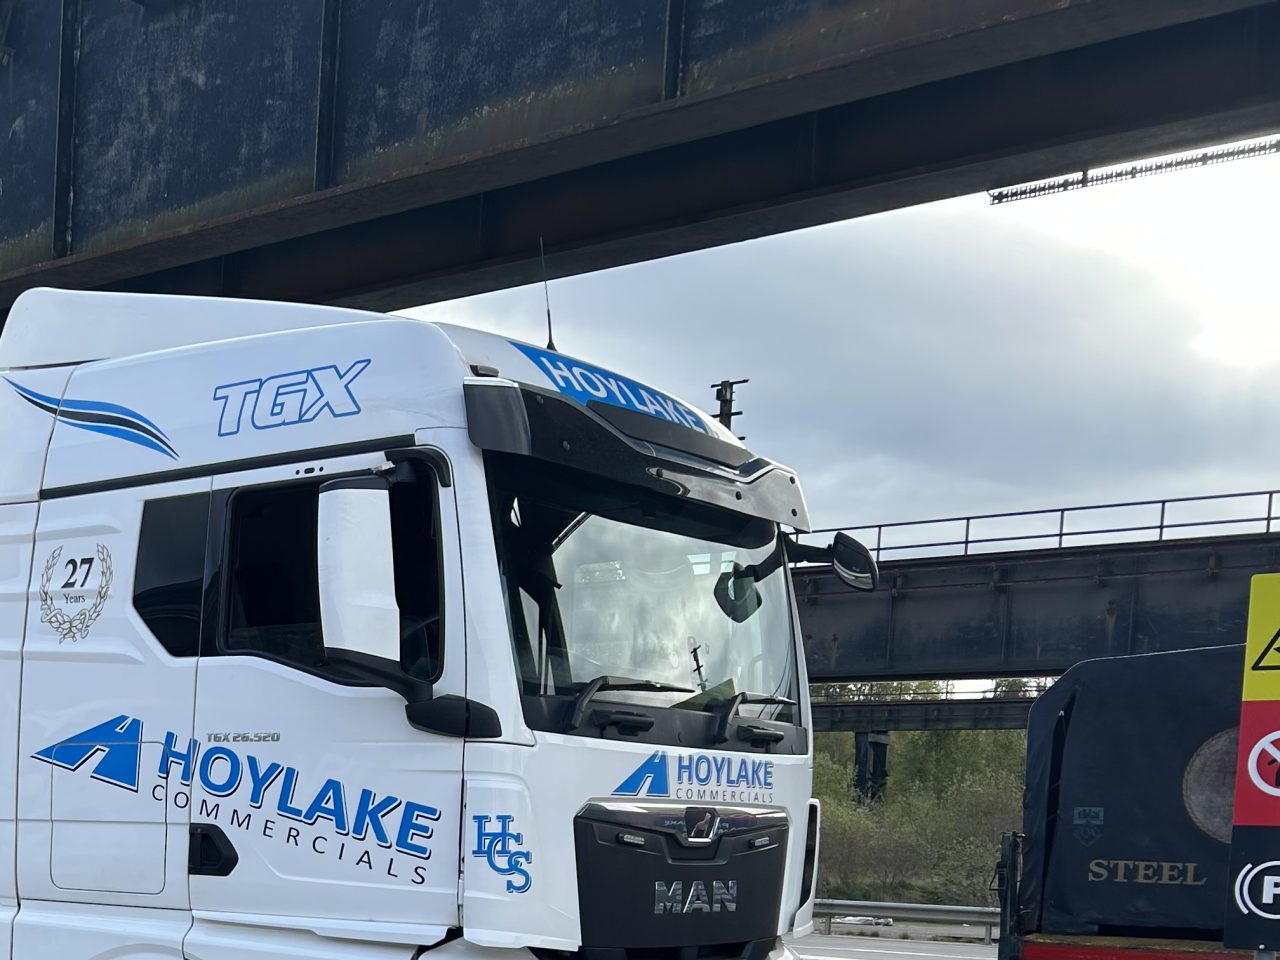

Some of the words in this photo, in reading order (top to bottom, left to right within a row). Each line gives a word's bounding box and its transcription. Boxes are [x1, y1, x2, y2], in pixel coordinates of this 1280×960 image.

[213, 358, 372, 437] TGX
[540, 356, 707, 434] HOYLAKE
[61, 557, 95, 589] 27
[63, 593, 86, 604] Years
[206, 732, 231, 743] TGX
[232, 732, 281, 743] 26.520
[677, 753, 774, 789] HOYLAKE
[158, 730, 442, 860] HOYLAKE
[676, 787, 773, 803] COMMERCIALS
[152, 783, 427, 885] COMMERCIALS
[1088, 859, 1208, 886] STEEL
[654, 880, 737, 914] MAN
